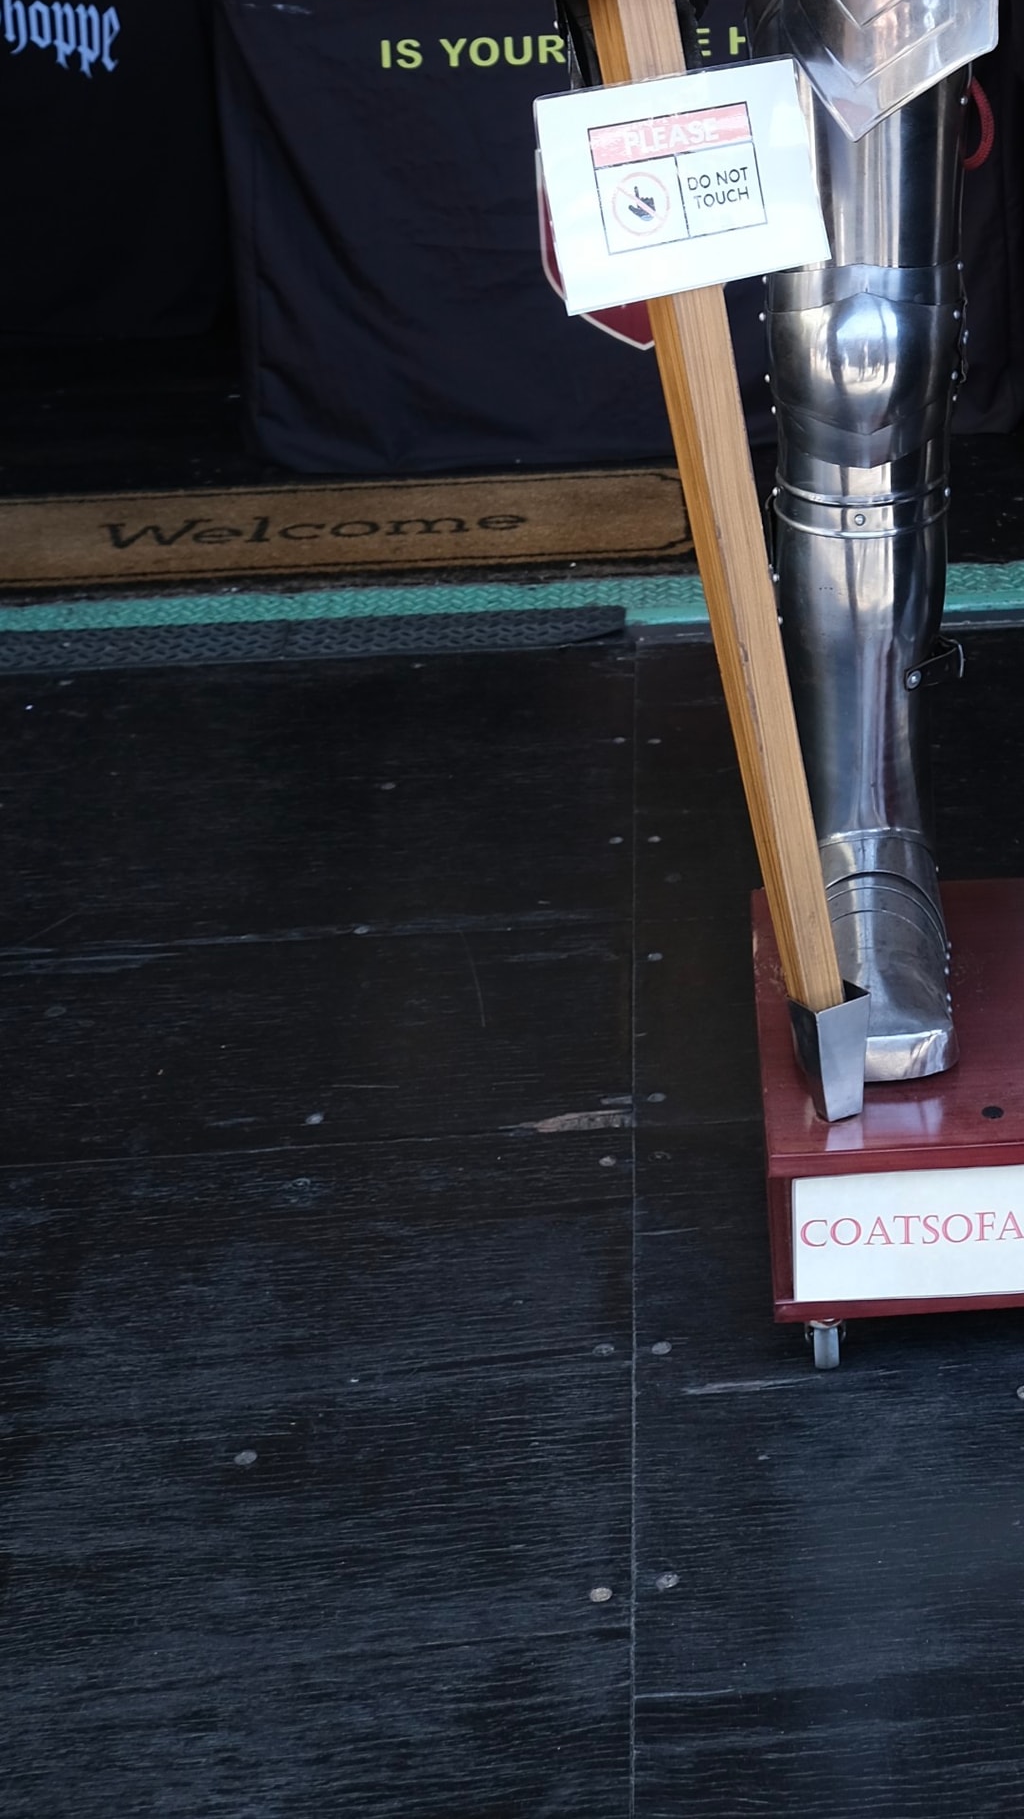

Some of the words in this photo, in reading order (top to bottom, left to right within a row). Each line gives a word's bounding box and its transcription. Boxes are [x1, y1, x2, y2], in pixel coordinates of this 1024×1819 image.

[380, 38, 423, 69] IS
[439, 35, 567, 67] YOUR
[622, 117, 720, 156] PLEASE
[687, 174, 711, 191] DO
[715, 166, 748, 186] NOT
[693, 186, 750, 209] TOUCH
[103, 511, 528, 550] Welcome
